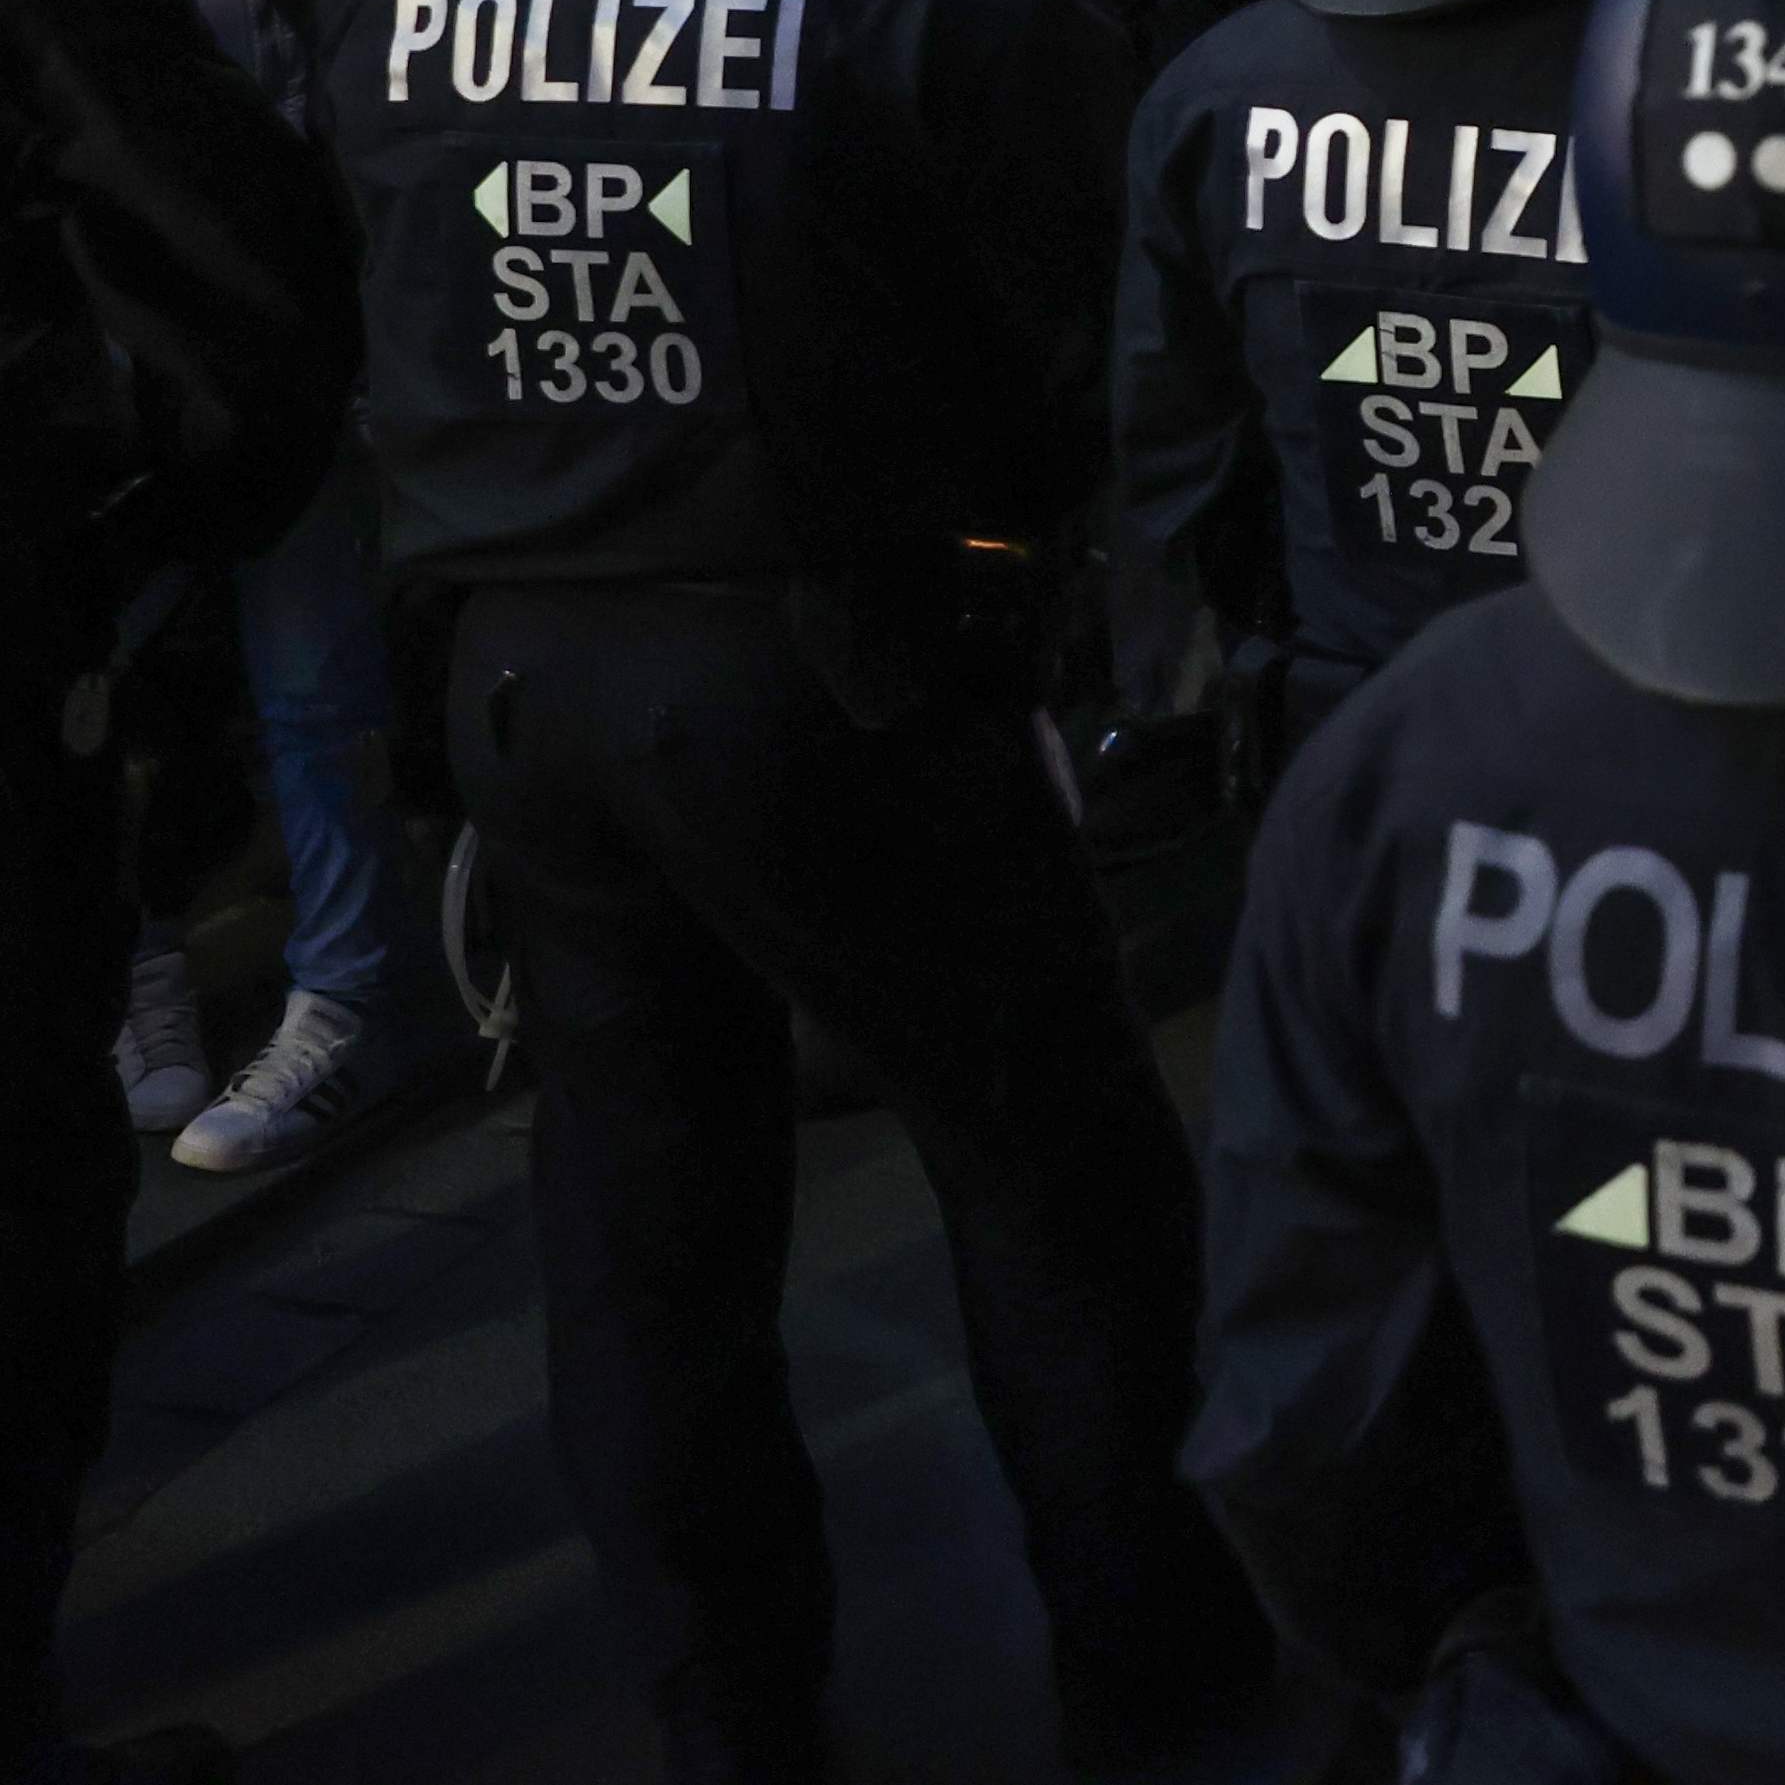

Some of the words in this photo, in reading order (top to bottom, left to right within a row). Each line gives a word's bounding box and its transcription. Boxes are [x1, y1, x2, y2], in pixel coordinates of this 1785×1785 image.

[514, 159, 644, 240] BP
[1244, 105, 1590, 264] POLIZ
[491, 245, 686, 324] STA
[486, 327, 703, 406] 1330
[1376, 310, 1510, 395] BP
[1359, 394, 1543, 478] STA
